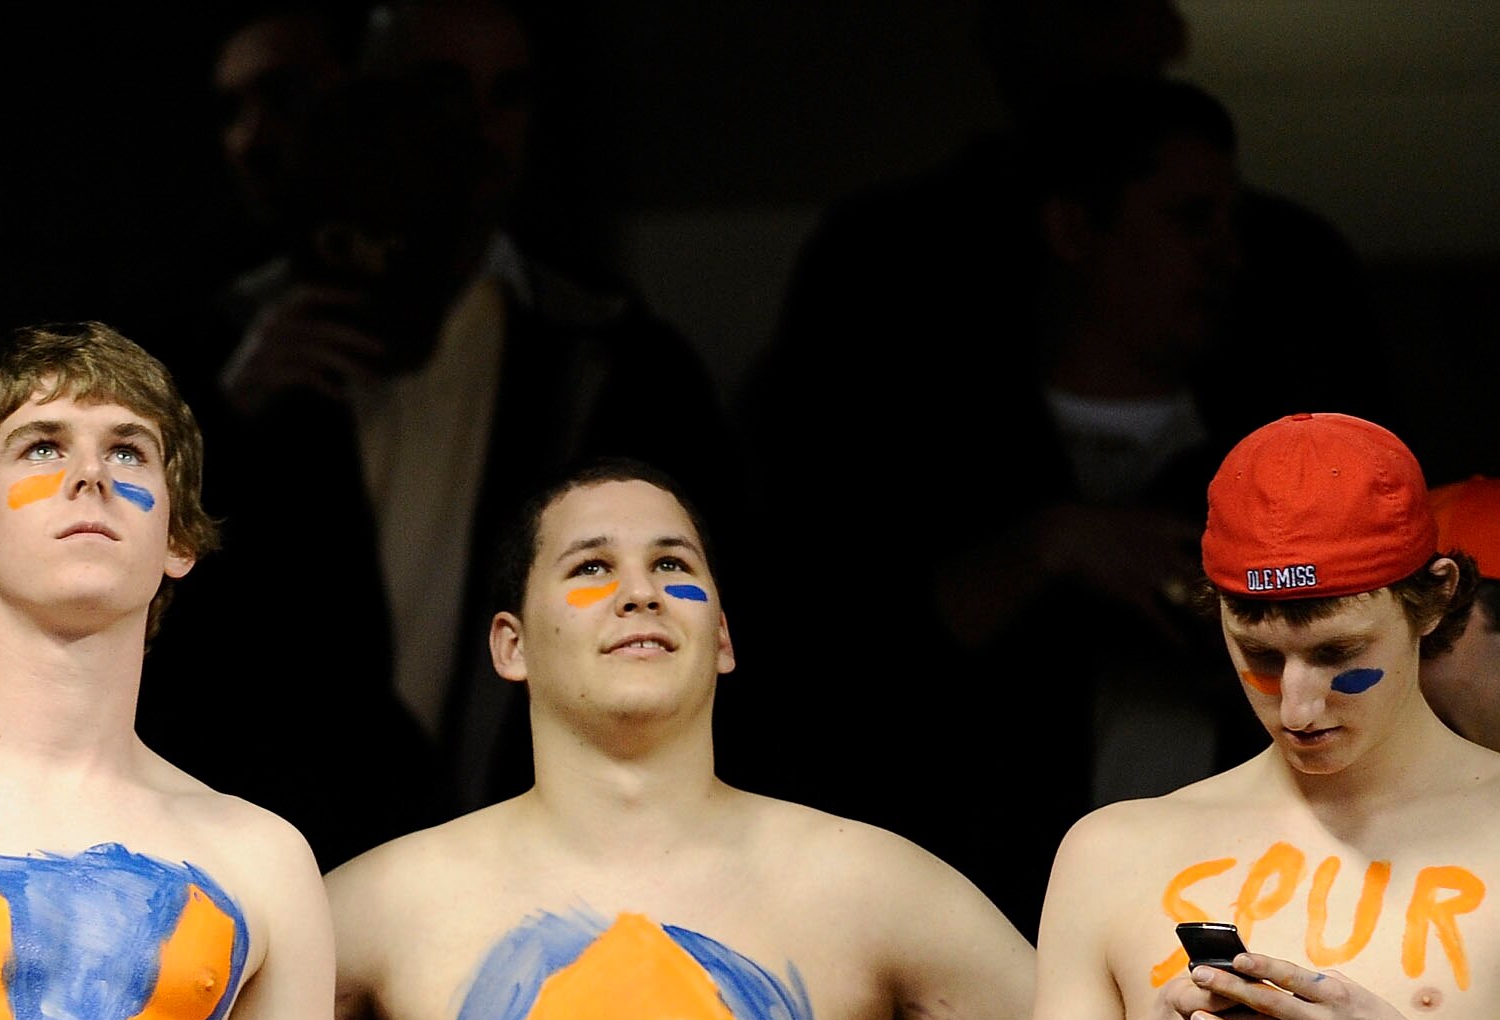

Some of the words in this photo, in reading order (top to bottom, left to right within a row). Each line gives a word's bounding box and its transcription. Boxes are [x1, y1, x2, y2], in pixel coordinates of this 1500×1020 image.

[1247, 570, 1274, 591] OLE
[1275, 565, 1317, 588] MISS
[1150, 841, 1485, 991] SPUR
